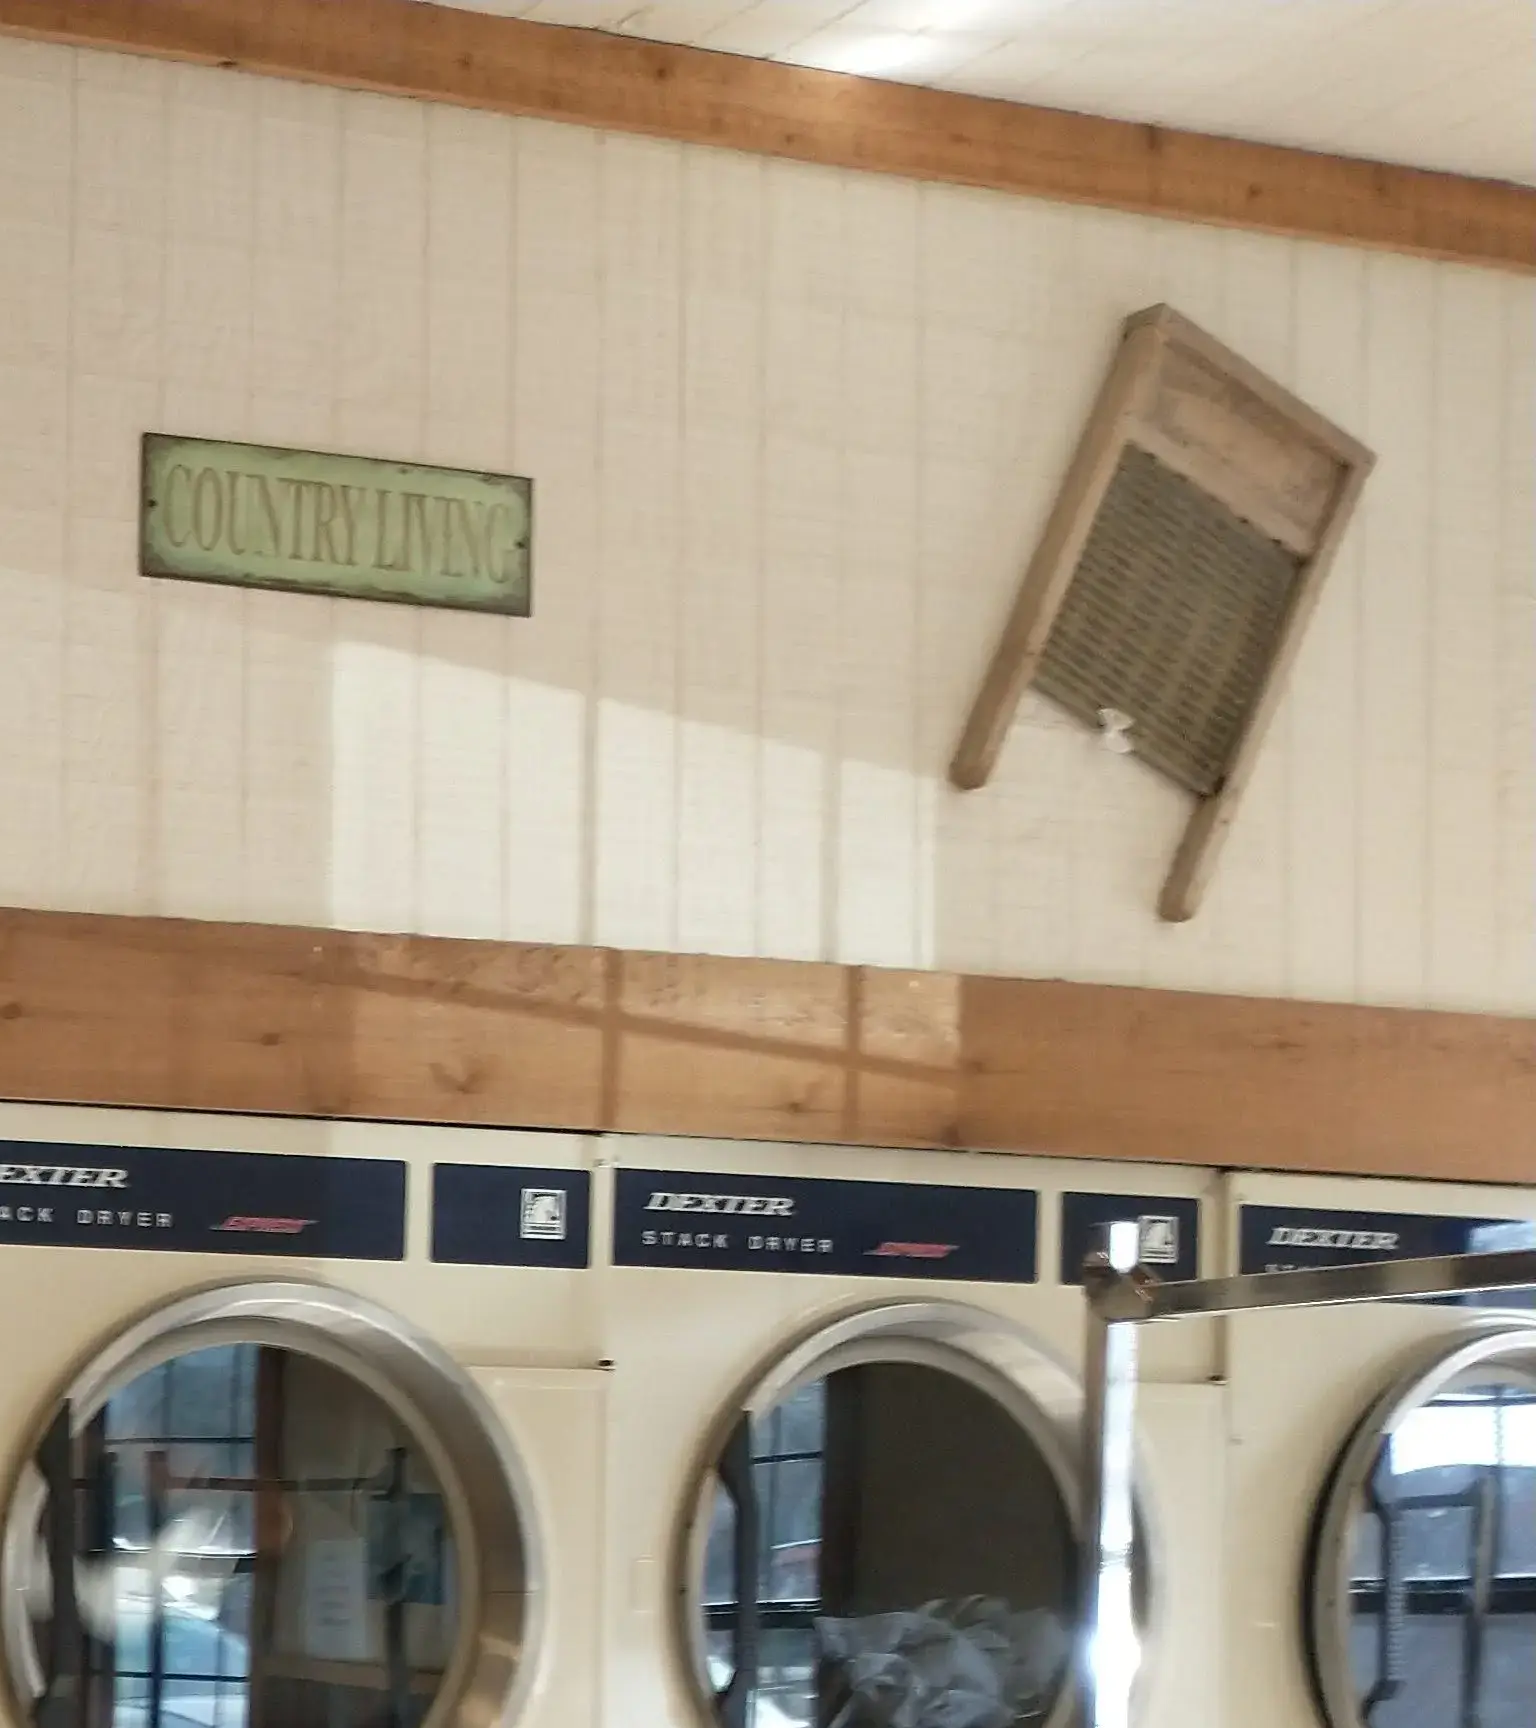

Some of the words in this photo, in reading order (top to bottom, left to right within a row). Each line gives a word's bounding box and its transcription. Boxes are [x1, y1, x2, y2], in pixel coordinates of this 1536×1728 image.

[162, 464, 367, 566] COUNTRY
[371, 489, 516, 584] LIVING
[643, 1192, 795, 1216] DEXTER
[77, 1209, 174, 1228] DRYER
[641, 1230, 729, 1249] STACK
[747, 1235, 834, 1253] DRYER
[1265, 1227, 1400, 1250] DEXTER
